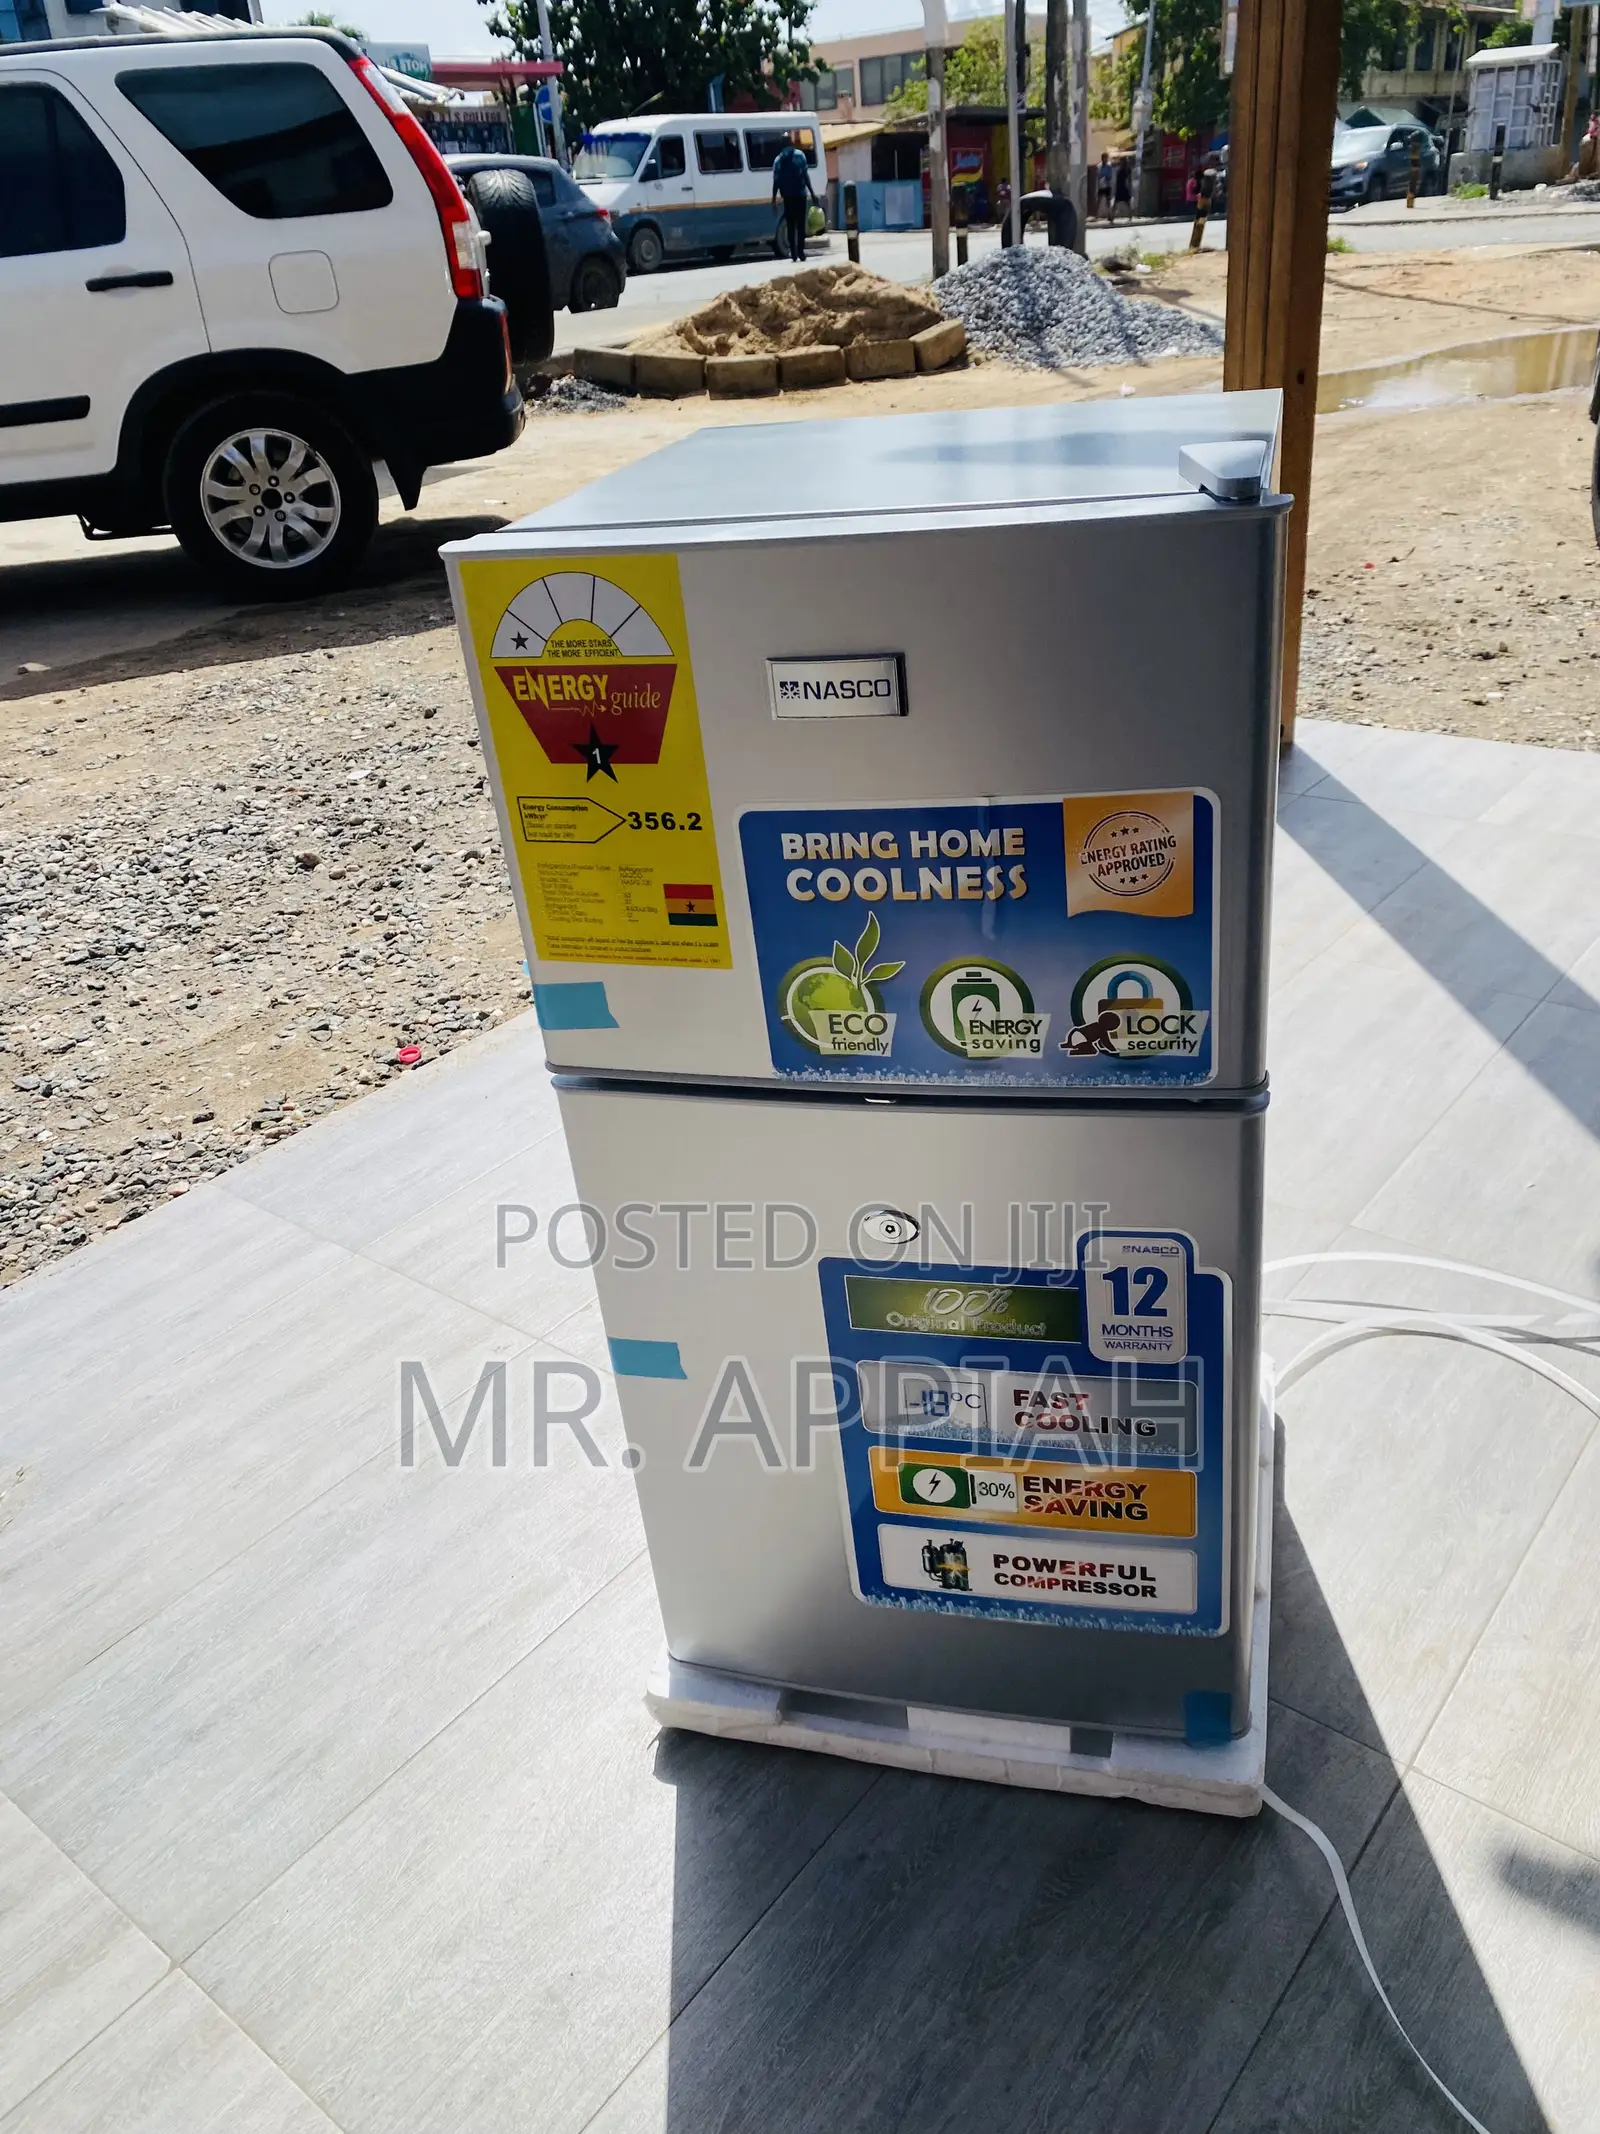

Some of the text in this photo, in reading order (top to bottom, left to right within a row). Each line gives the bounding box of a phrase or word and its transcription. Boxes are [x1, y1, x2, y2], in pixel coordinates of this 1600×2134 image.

[547, 648, 619, 658] THE MORE EFFICIENT
[551, 638, 613, 648] THE MORE STARS
[512, 667, 661, 716] ENERGY guide
[803, 679, 891, 700] NASCO
[592, 748, 601, 764] 1
[523, 803, 545, 813] Energy
[627, 811, 703, 831] 356.2
[780, 827, 1026, 860] BRING HOME
[1080, 835, 1177, 865] ENERGY RATING
[1097, 852, 1166, 878] APPROVED
[786, 864, 1029, 902] COOLNESS
[829, 1013, 889, 1036] ECO
[968, 1019, 1043, 1036] ENERGY
[1126, 1014, 1198, 1035] LOCK
[831, 1036, 889, 1055] friendly
[972, 1036, 1042, 1053] saving
[1127, 1036, 1199, 1054] security
[1131, 1245, 1180, 1255] NASCO
[923, 1287, 1013, 1317] 100%
[1102, 1265, 1169, 1318] 12
[886, 1311, 1047, 1336] Original Product
[1101, 1323, 1174, 1338] MONTHS
[1104, 1340, 1172, 1352] WARRANTY
[1013, 1389, 1091, 1411] FAST
[1014, 1411, 1158, 1437] COOLING
[978, 1480, 1016, 1499] 30%
[1022, 1475, 1149, 1501] ENERGY
[1022, 1494, 1149, 1521] SAVING
[992, 1553, 1157, 1582] POWERFUL
[993, 1572, 1158, 1599] COMPRESSOR
